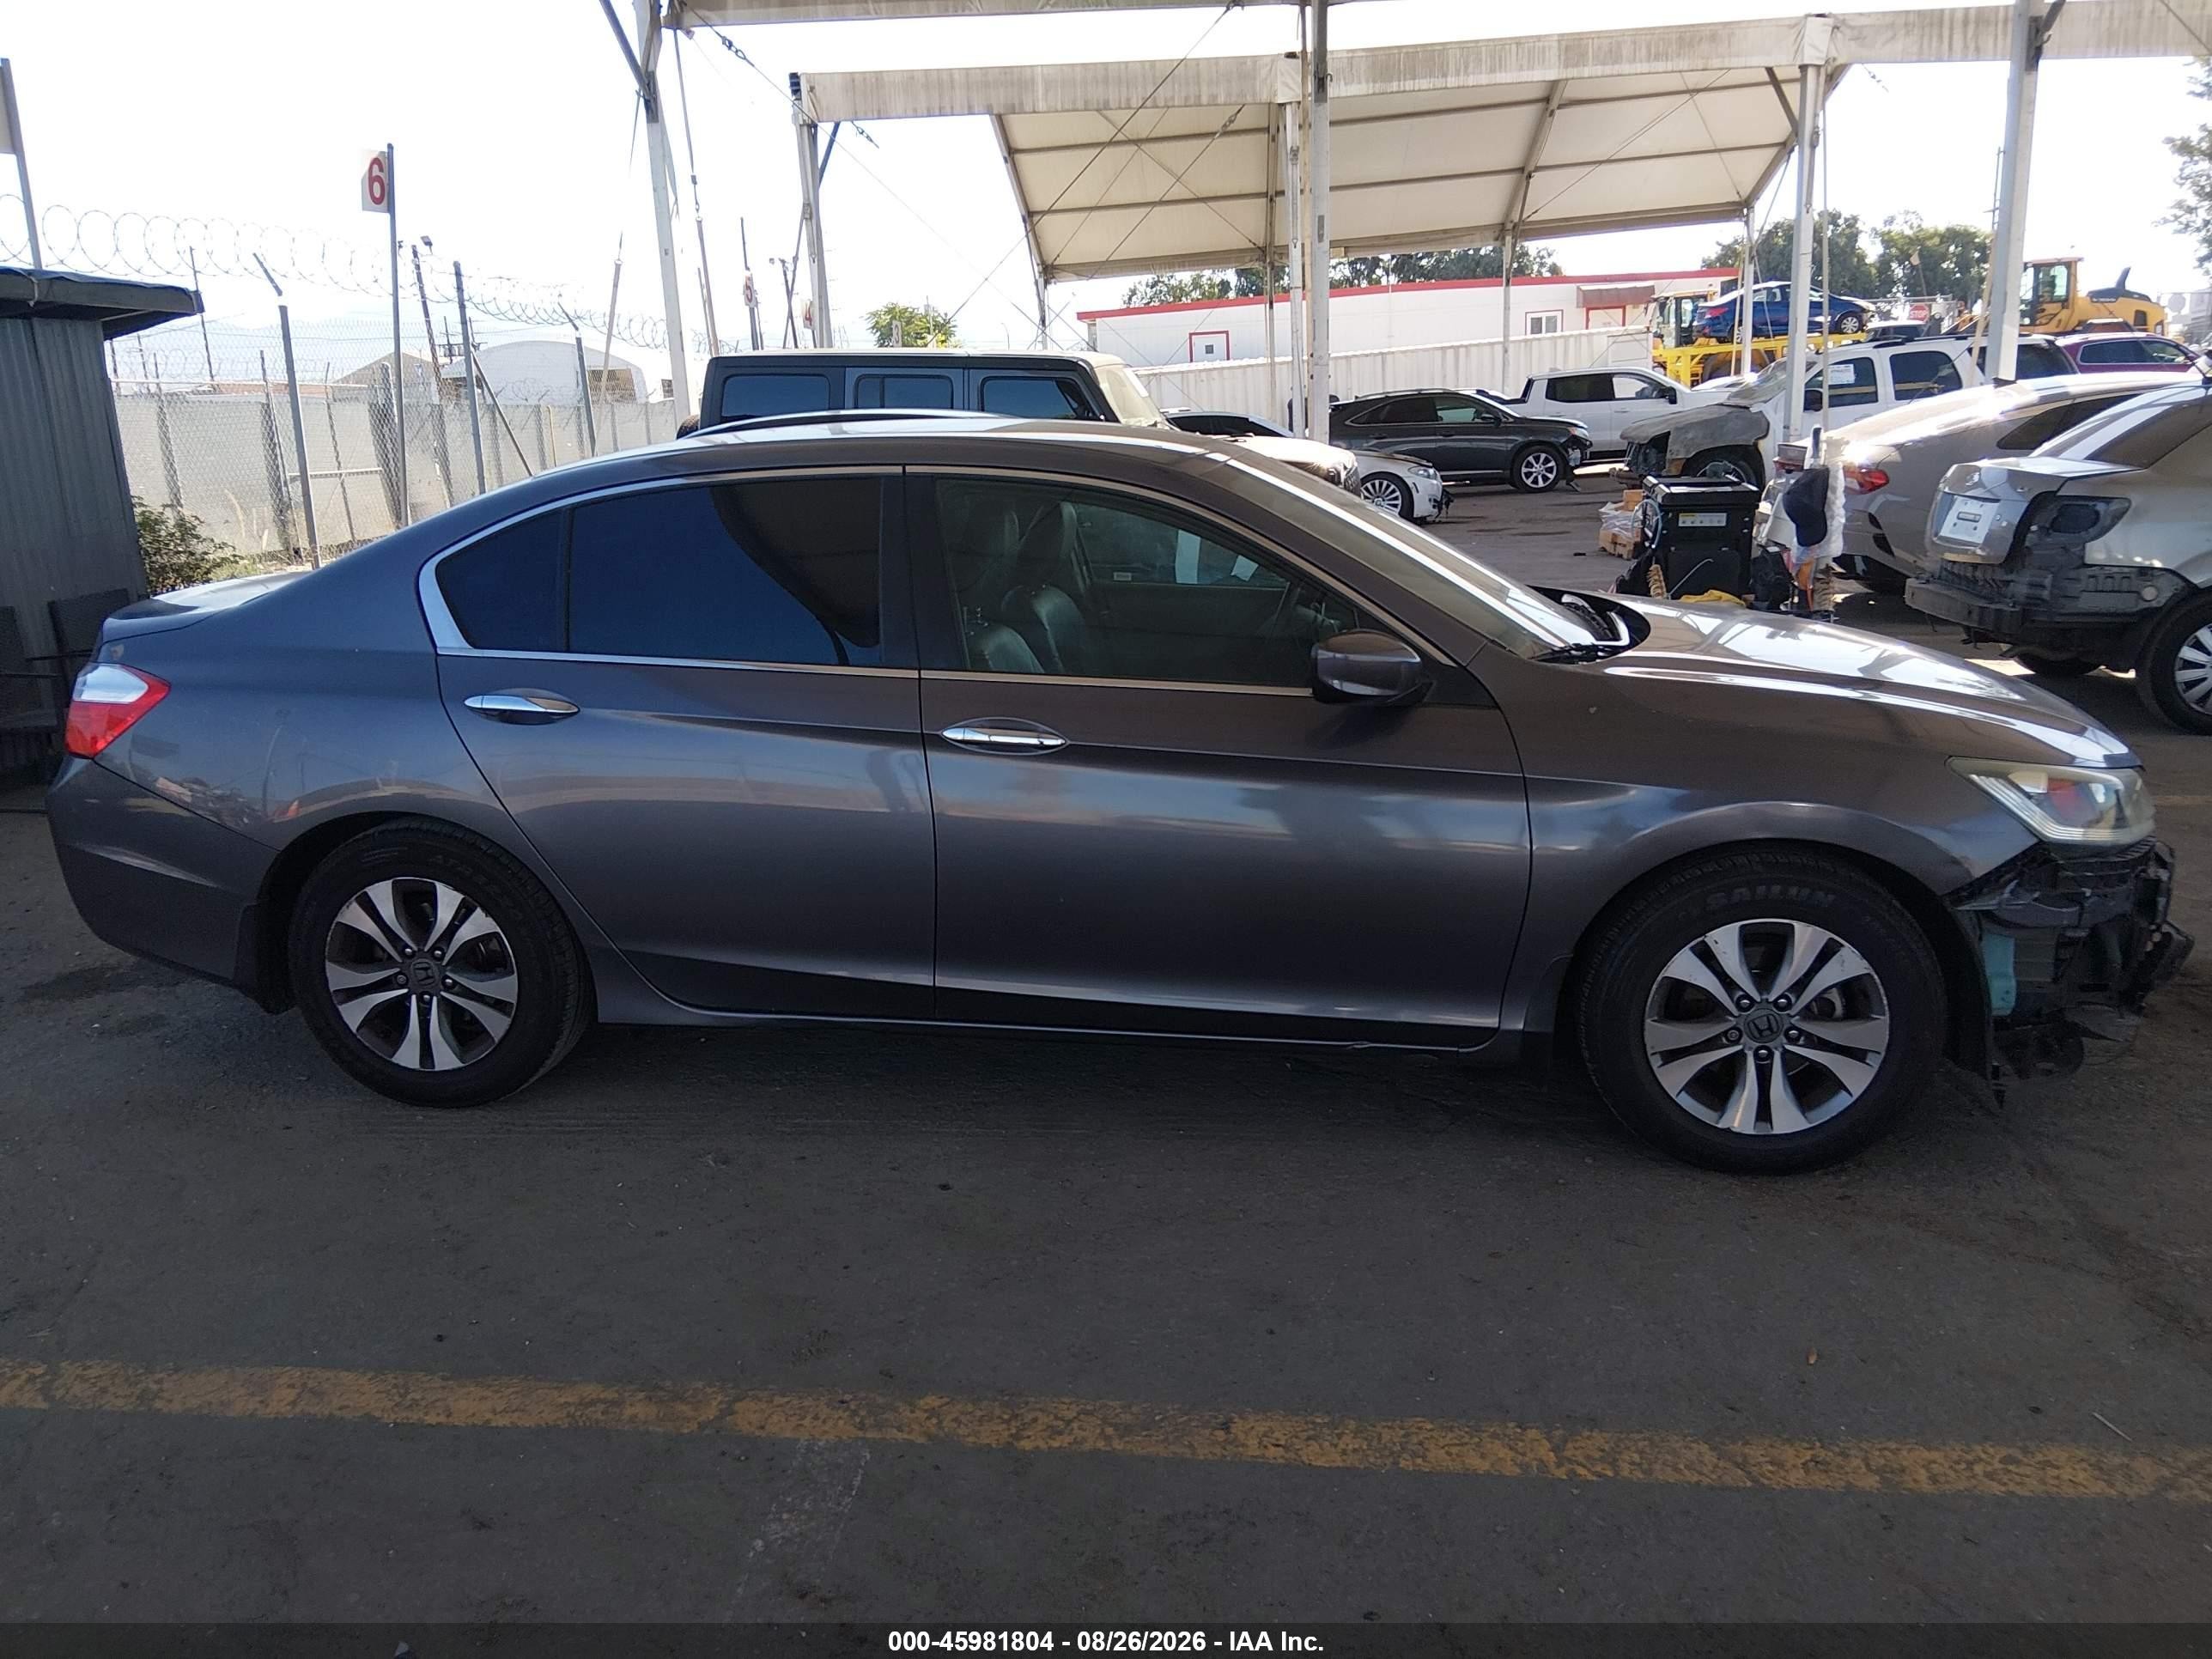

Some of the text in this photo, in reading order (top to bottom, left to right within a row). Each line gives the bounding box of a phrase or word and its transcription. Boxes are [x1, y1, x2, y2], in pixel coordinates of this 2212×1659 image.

[368, 157, 385, 205] 6
[744, 276, 753, 303] 5
[1910, 310, 1927, 319] STOP
